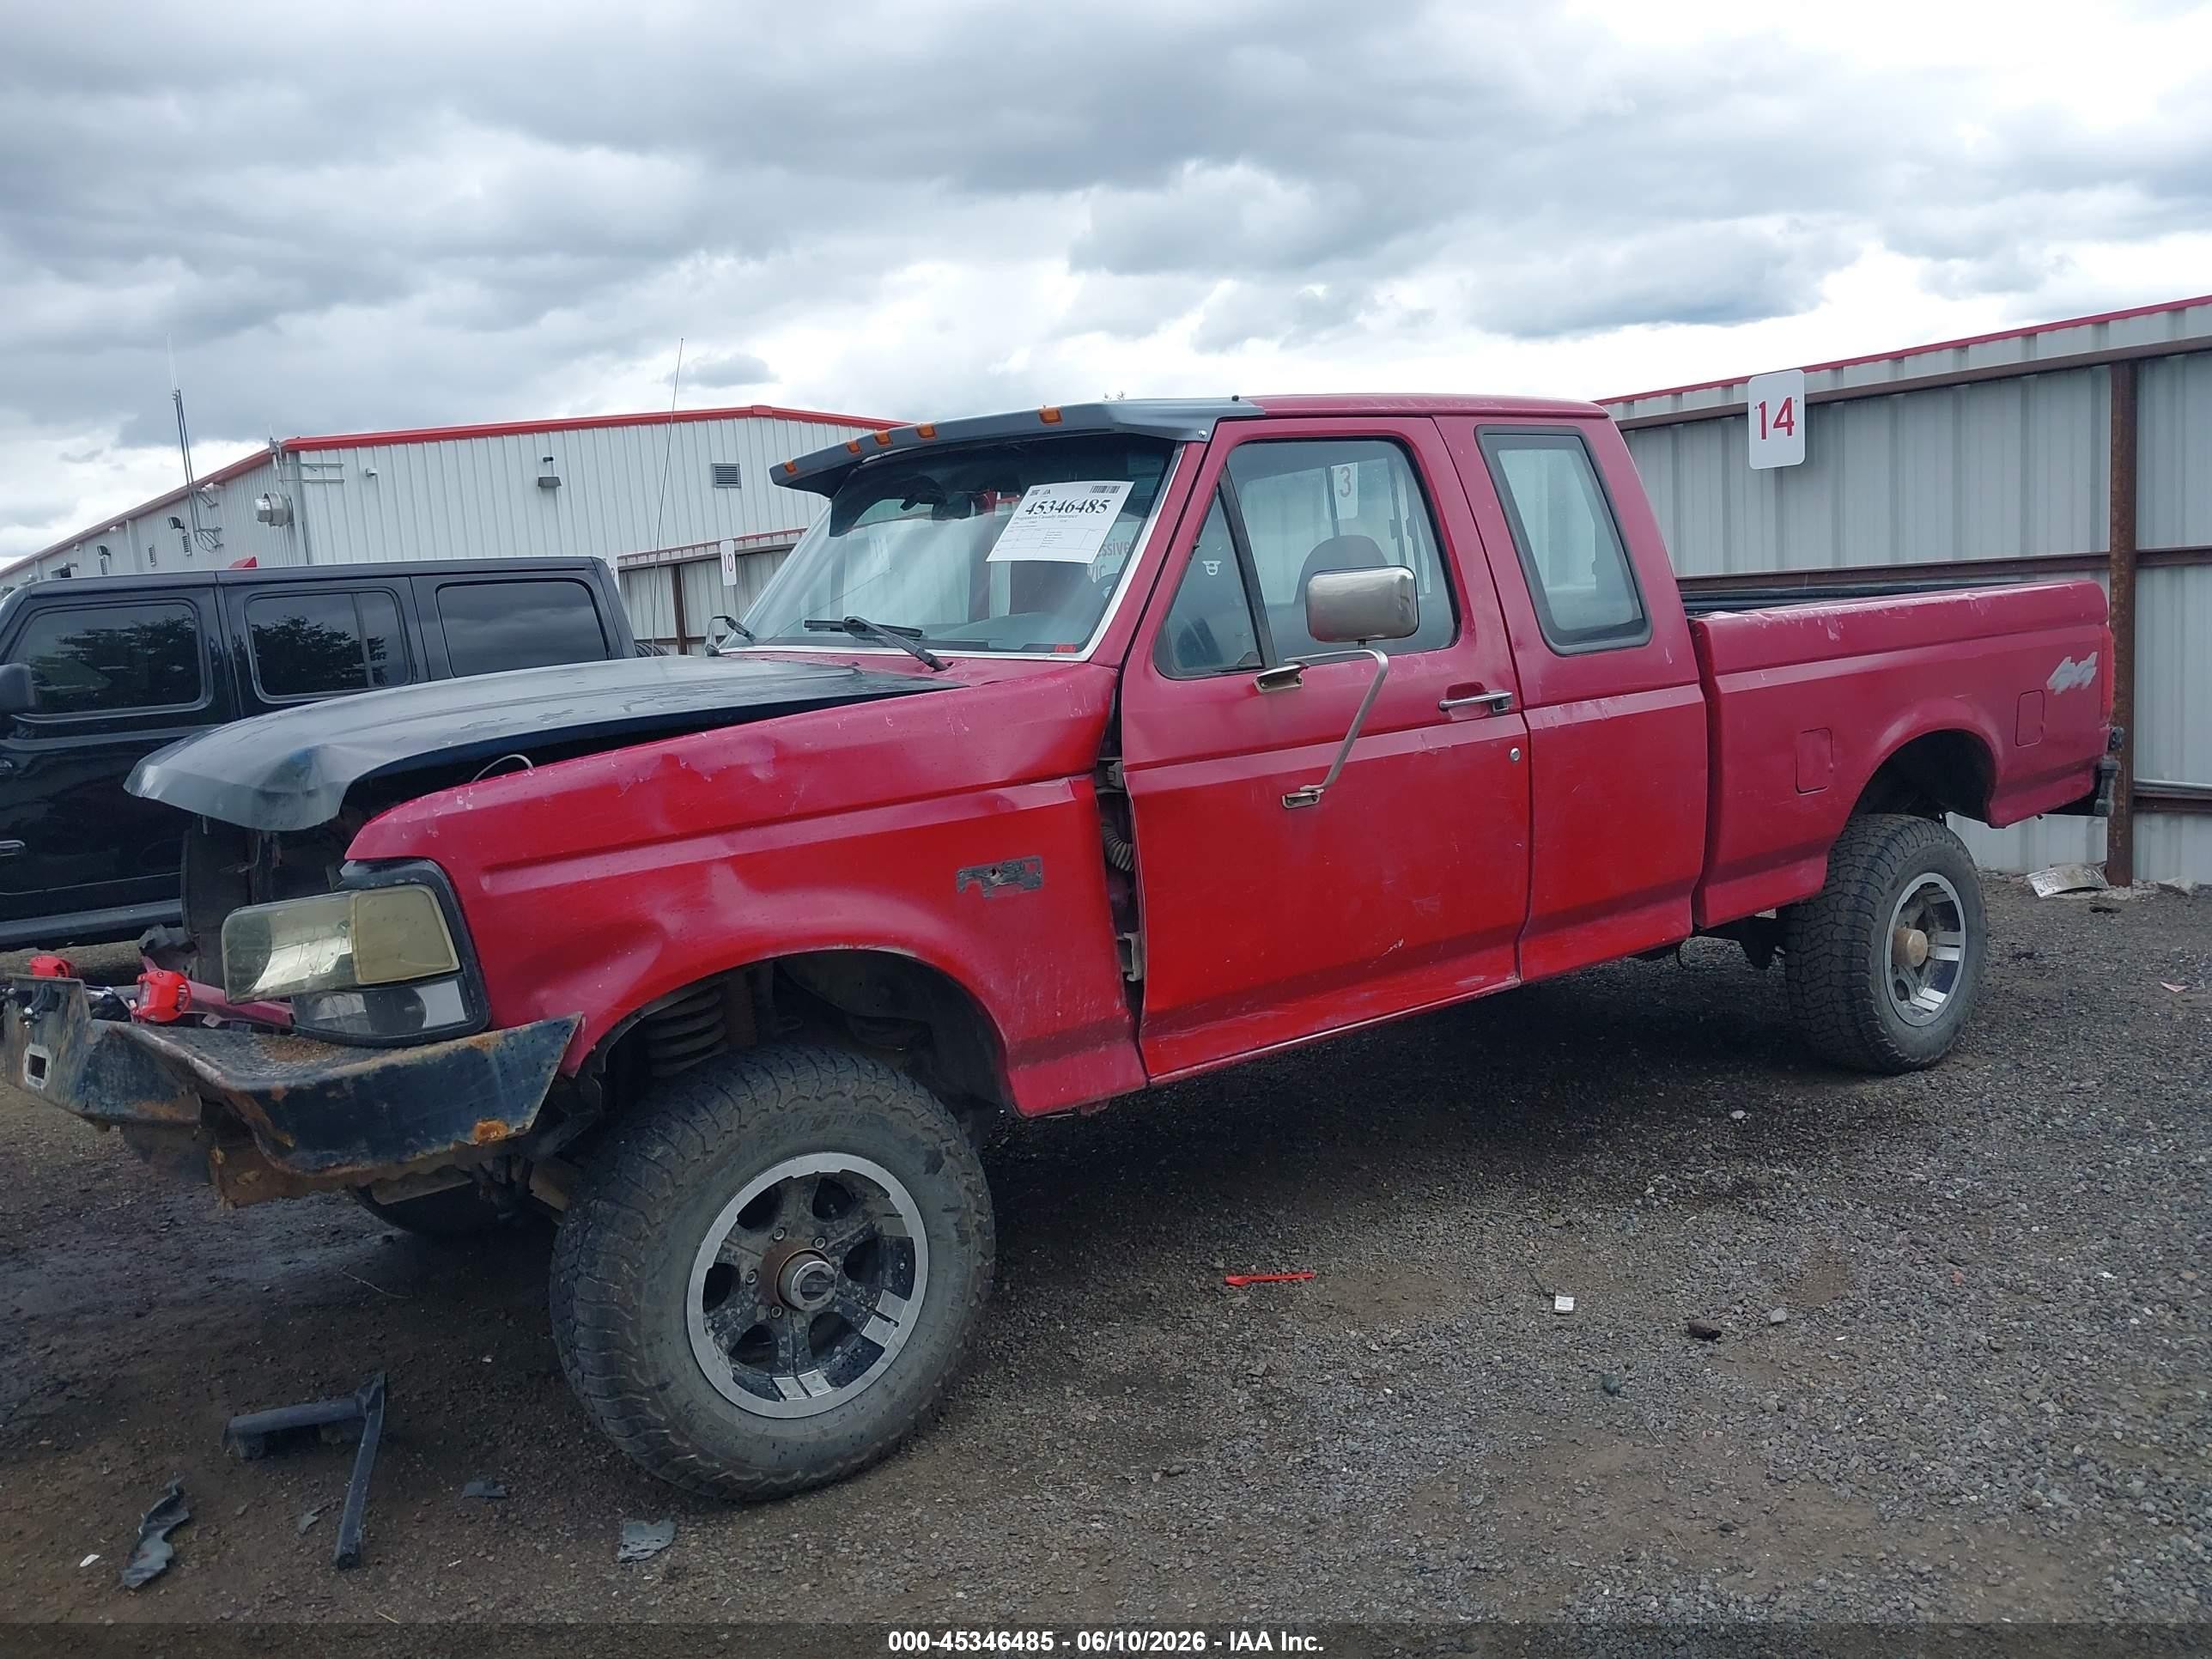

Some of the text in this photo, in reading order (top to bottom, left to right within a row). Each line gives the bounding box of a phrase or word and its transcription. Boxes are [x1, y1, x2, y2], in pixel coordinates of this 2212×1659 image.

[1758, 397, 1795, 441] 14
[1025, 499, 1111, 514] 45346485
[723, 553, 734, 574] 10
